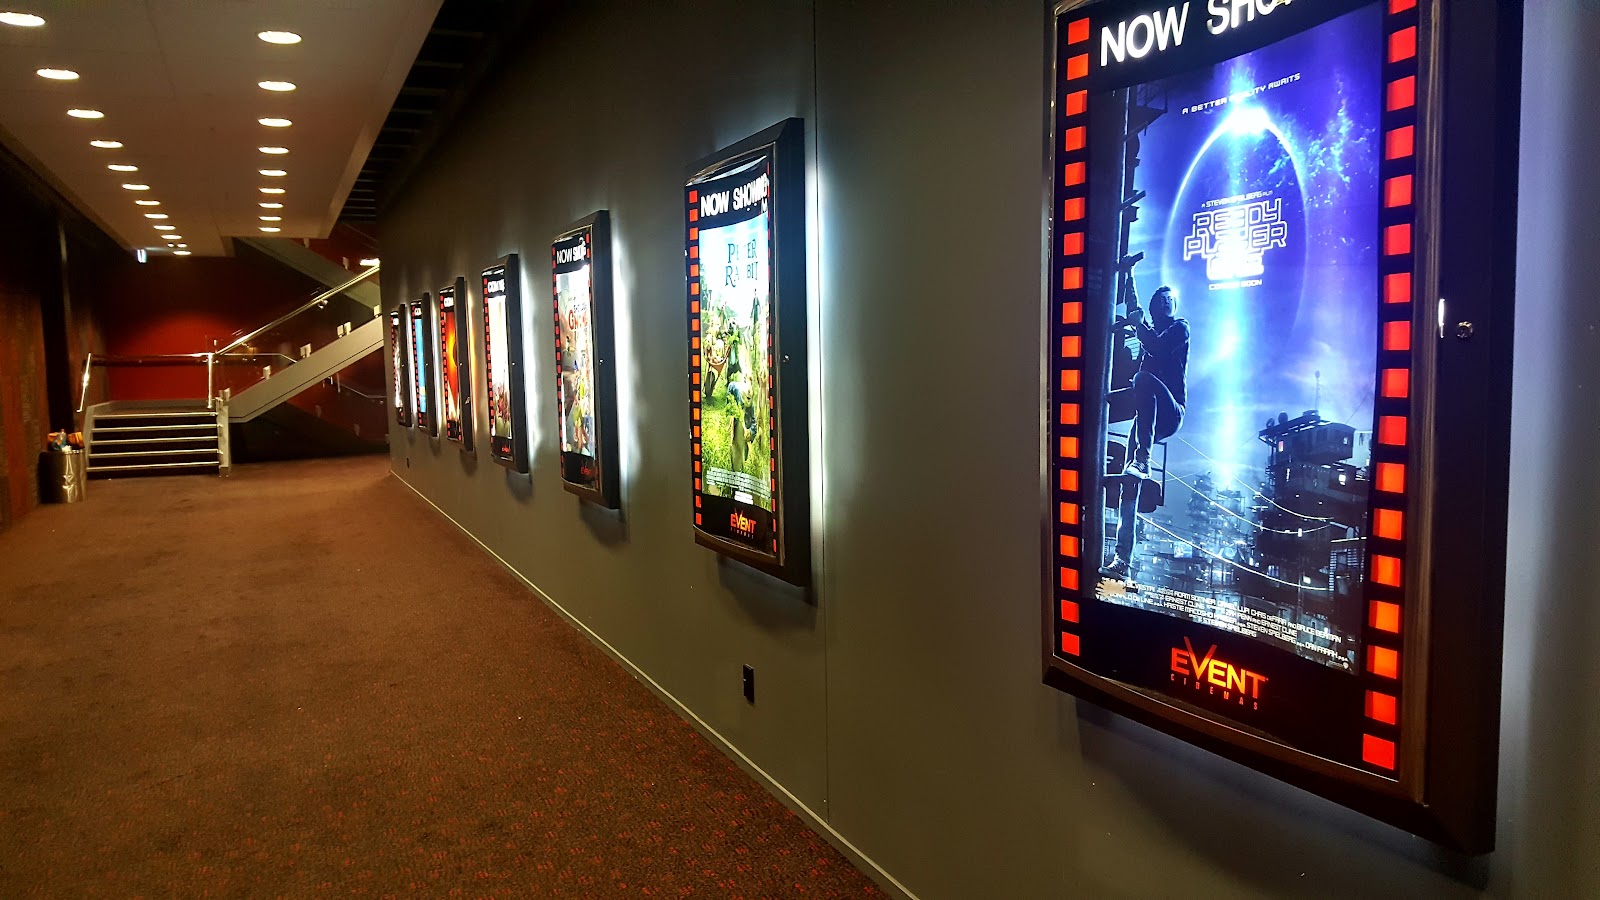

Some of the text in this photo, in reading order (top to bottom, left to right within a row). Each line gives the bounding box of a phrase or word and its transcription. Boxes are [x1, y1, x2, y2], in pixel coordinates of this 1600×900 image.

[1100, 1, 1190, 67] NOW
[1182, 72, 1301, 115] A BETTER LITY AWAITS
[700, 190, 730, 218] NOW
[727, 239, 758, 264] PER
[1183, 220, 1288, 261] PLER
[556, 248, 573, 265] NOW
[725, 261, 759, 288] RABIT
[730, 508, 757, 534] EVENT
[1246, 621, 1269, 634] STEVEN
[1297, 622, 1315, 635] BRUCE
[1171, 635, 1269, 699] EVENT
[1170, 673, 1258, 711] CINEMAS
